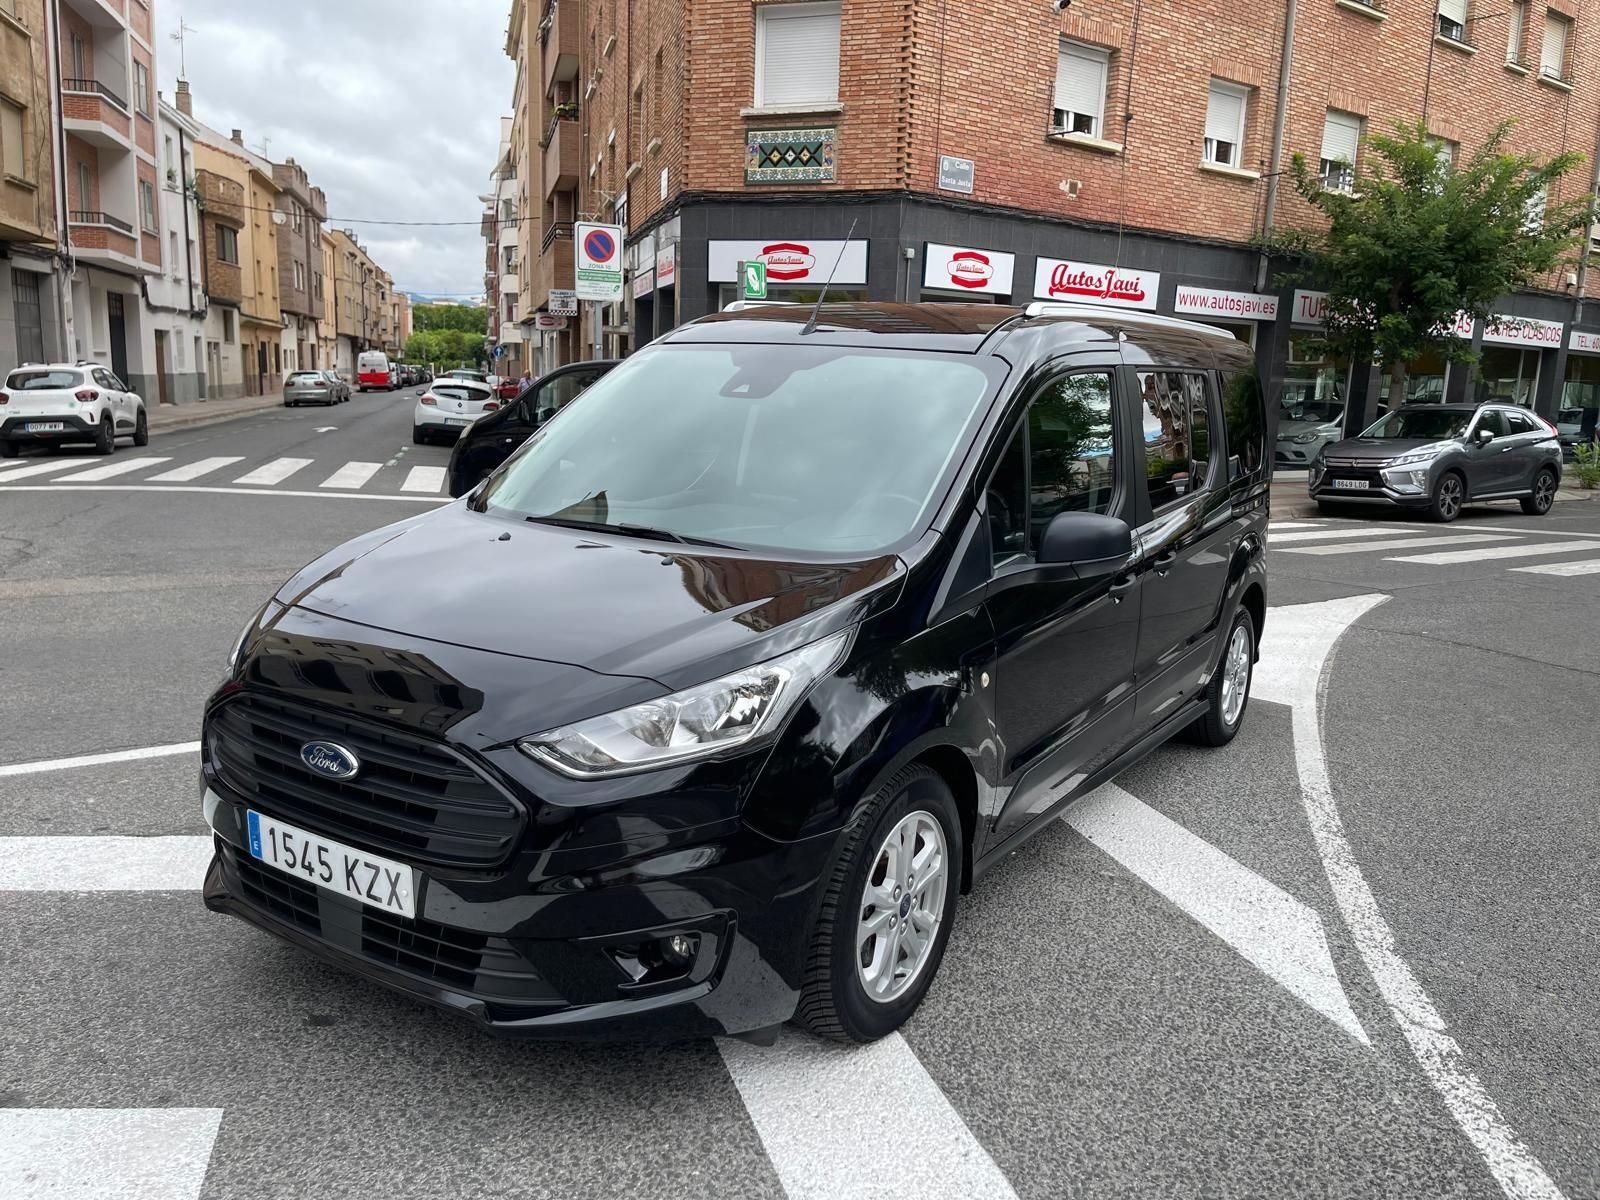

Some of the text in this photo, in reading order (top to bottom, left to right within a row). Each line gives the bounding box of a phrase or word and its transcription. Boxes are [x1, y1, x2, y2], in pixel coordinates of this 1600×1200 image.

[955, 161, 970, 171] Calle
[942, 175, 956, 185] Santa
[1179, 293, 1276, 315] www.autosjavi.es
[309, 745, 339, 772] Ford
[268, 827, 404, 911] 1545 KZX
